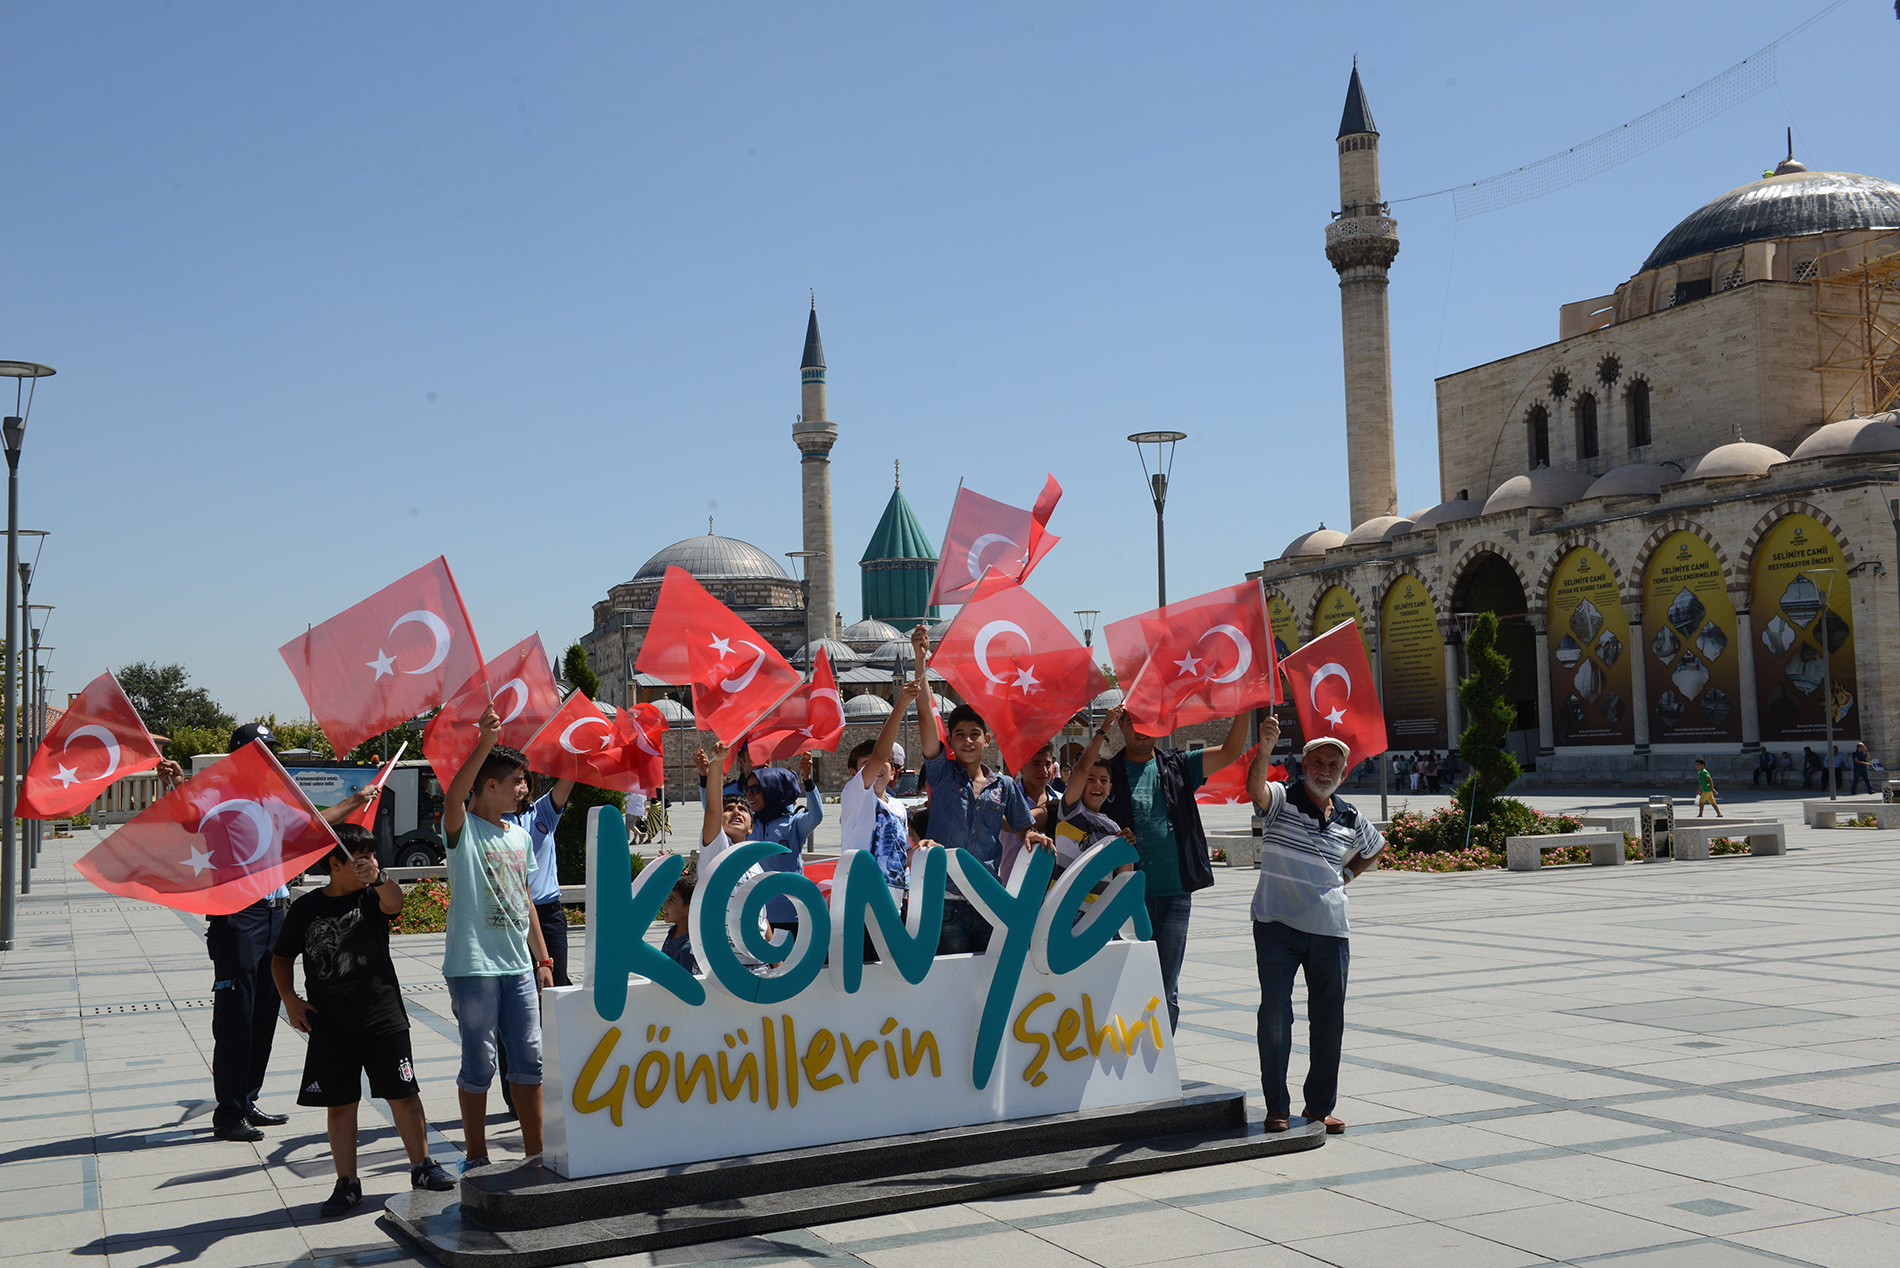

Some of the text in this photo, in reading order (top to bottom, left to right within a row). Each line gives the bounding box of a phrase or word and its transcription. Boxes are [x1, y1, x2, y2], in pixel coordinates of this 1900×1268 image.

[1773, 545, 1828, 561] SELİMİYE CAMİİ
[1661, 560, 1709, 575] SELİMİYE CAMİİ
[1768, 555, 1834, 571] RESTORASYON ÖNCESİ
[1563, 576, 1589, 587] SELİMİYE
[1653, 569, 1719, 585] TEMEL GÜÇLENDİRMELERİ
[1580, 584, 1596, 592] KUBBE
[573, 992, 1165, 1127] Gönüllerin Şehri
